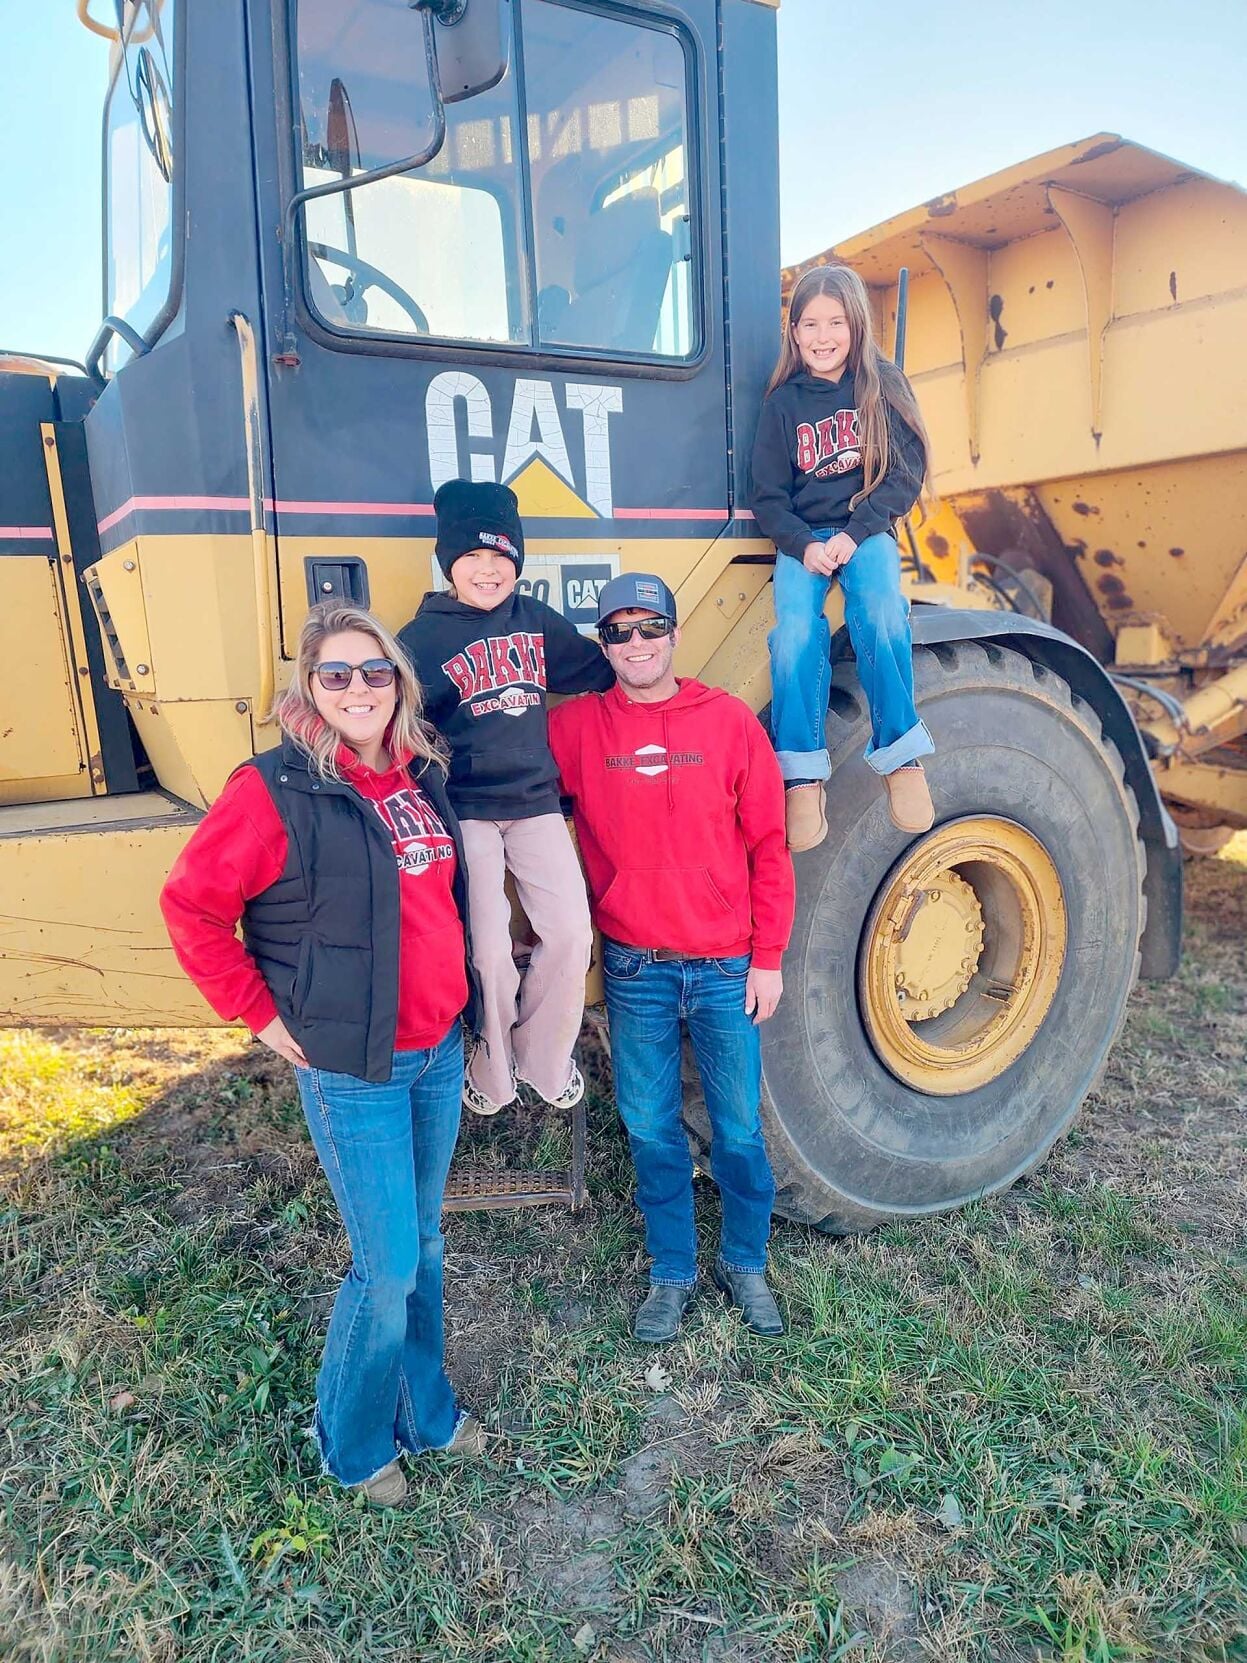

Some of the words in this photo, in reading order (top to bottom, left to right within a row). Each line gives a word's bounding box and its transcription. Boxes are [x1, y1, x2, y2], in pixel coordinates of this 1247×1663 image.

[425, 371, 622, 518] CAT
[796, 409, 861, 474] BAK
[471, 693, 541, 716] EXCAVATIN
[605, 757, 634, 768] BAKKE
[396, 845, 453, 868] CAVATING
